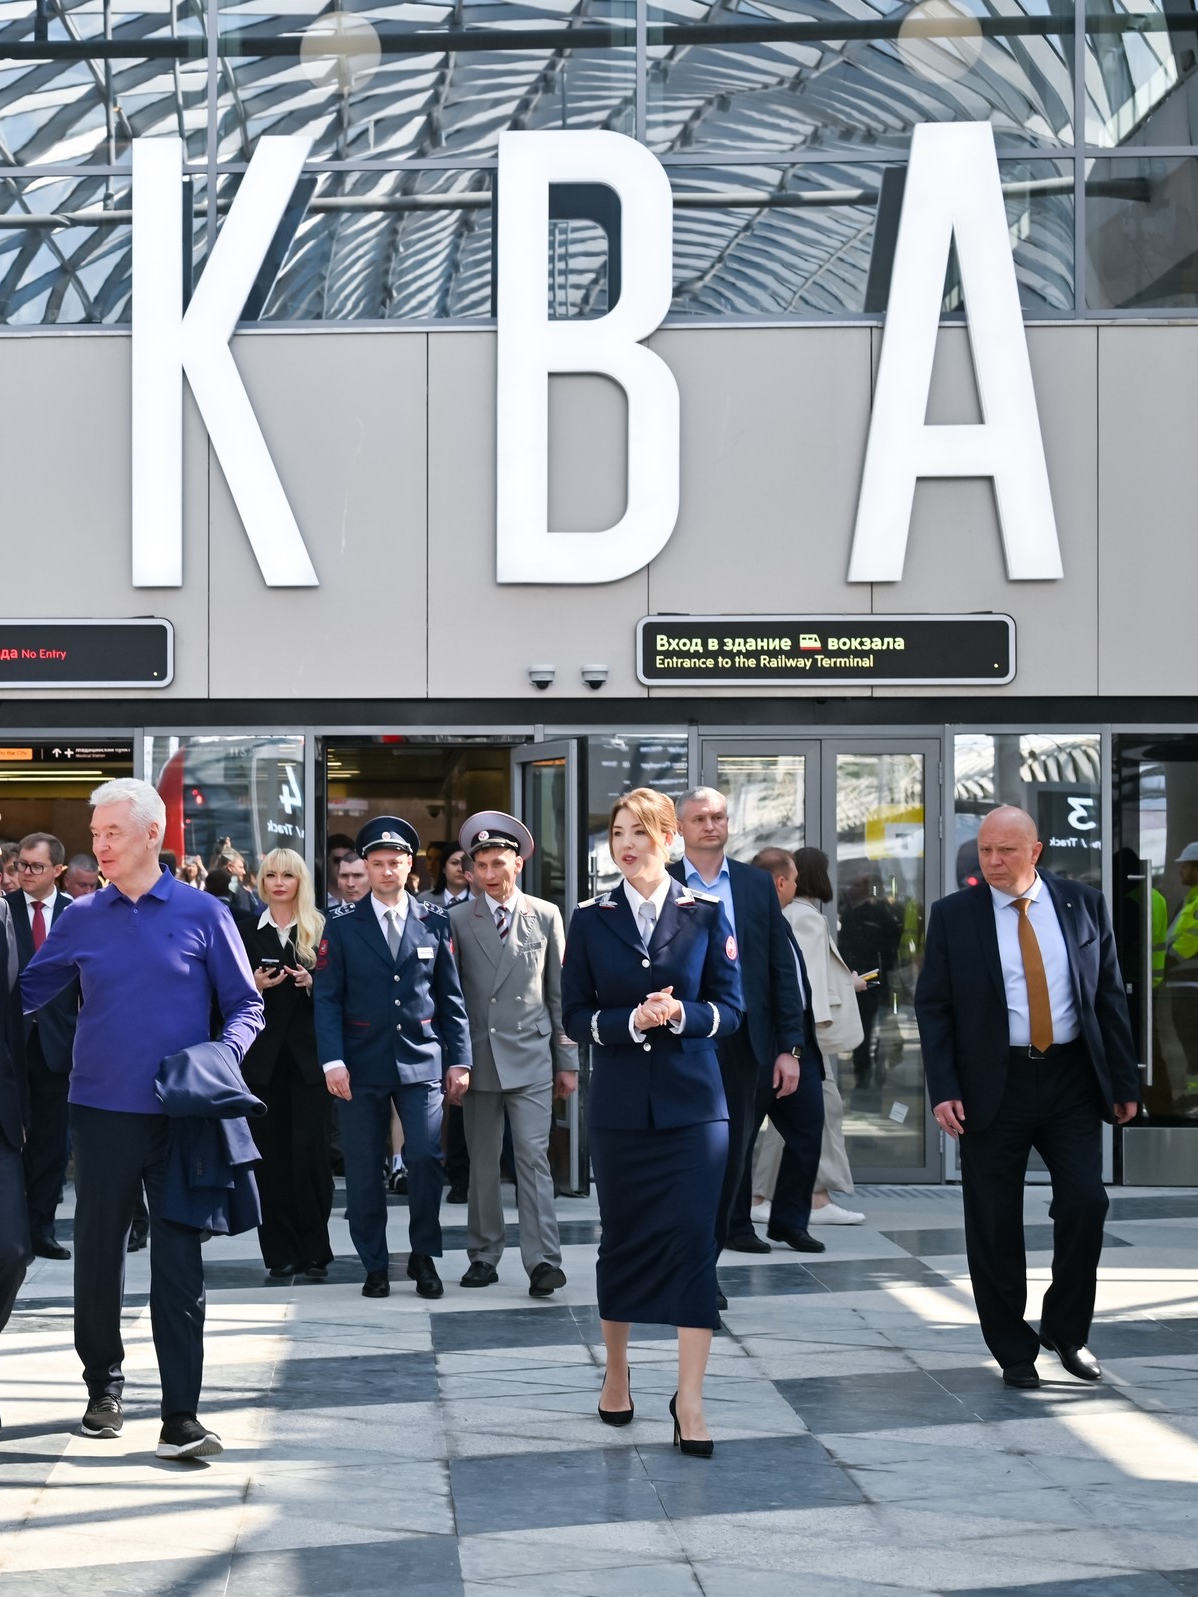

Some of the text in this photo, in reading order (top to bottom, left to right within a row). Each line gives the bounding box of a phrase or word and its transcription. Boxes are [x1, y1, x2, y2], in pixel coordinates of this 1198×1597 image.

[657, 635, 904, 653] Вход в здание вокзала
[21, 650, 37, 658] No
[39, 649, 66, 660] Entry
[656, 655, 873, 669] Entrance to the Railway Terminal
